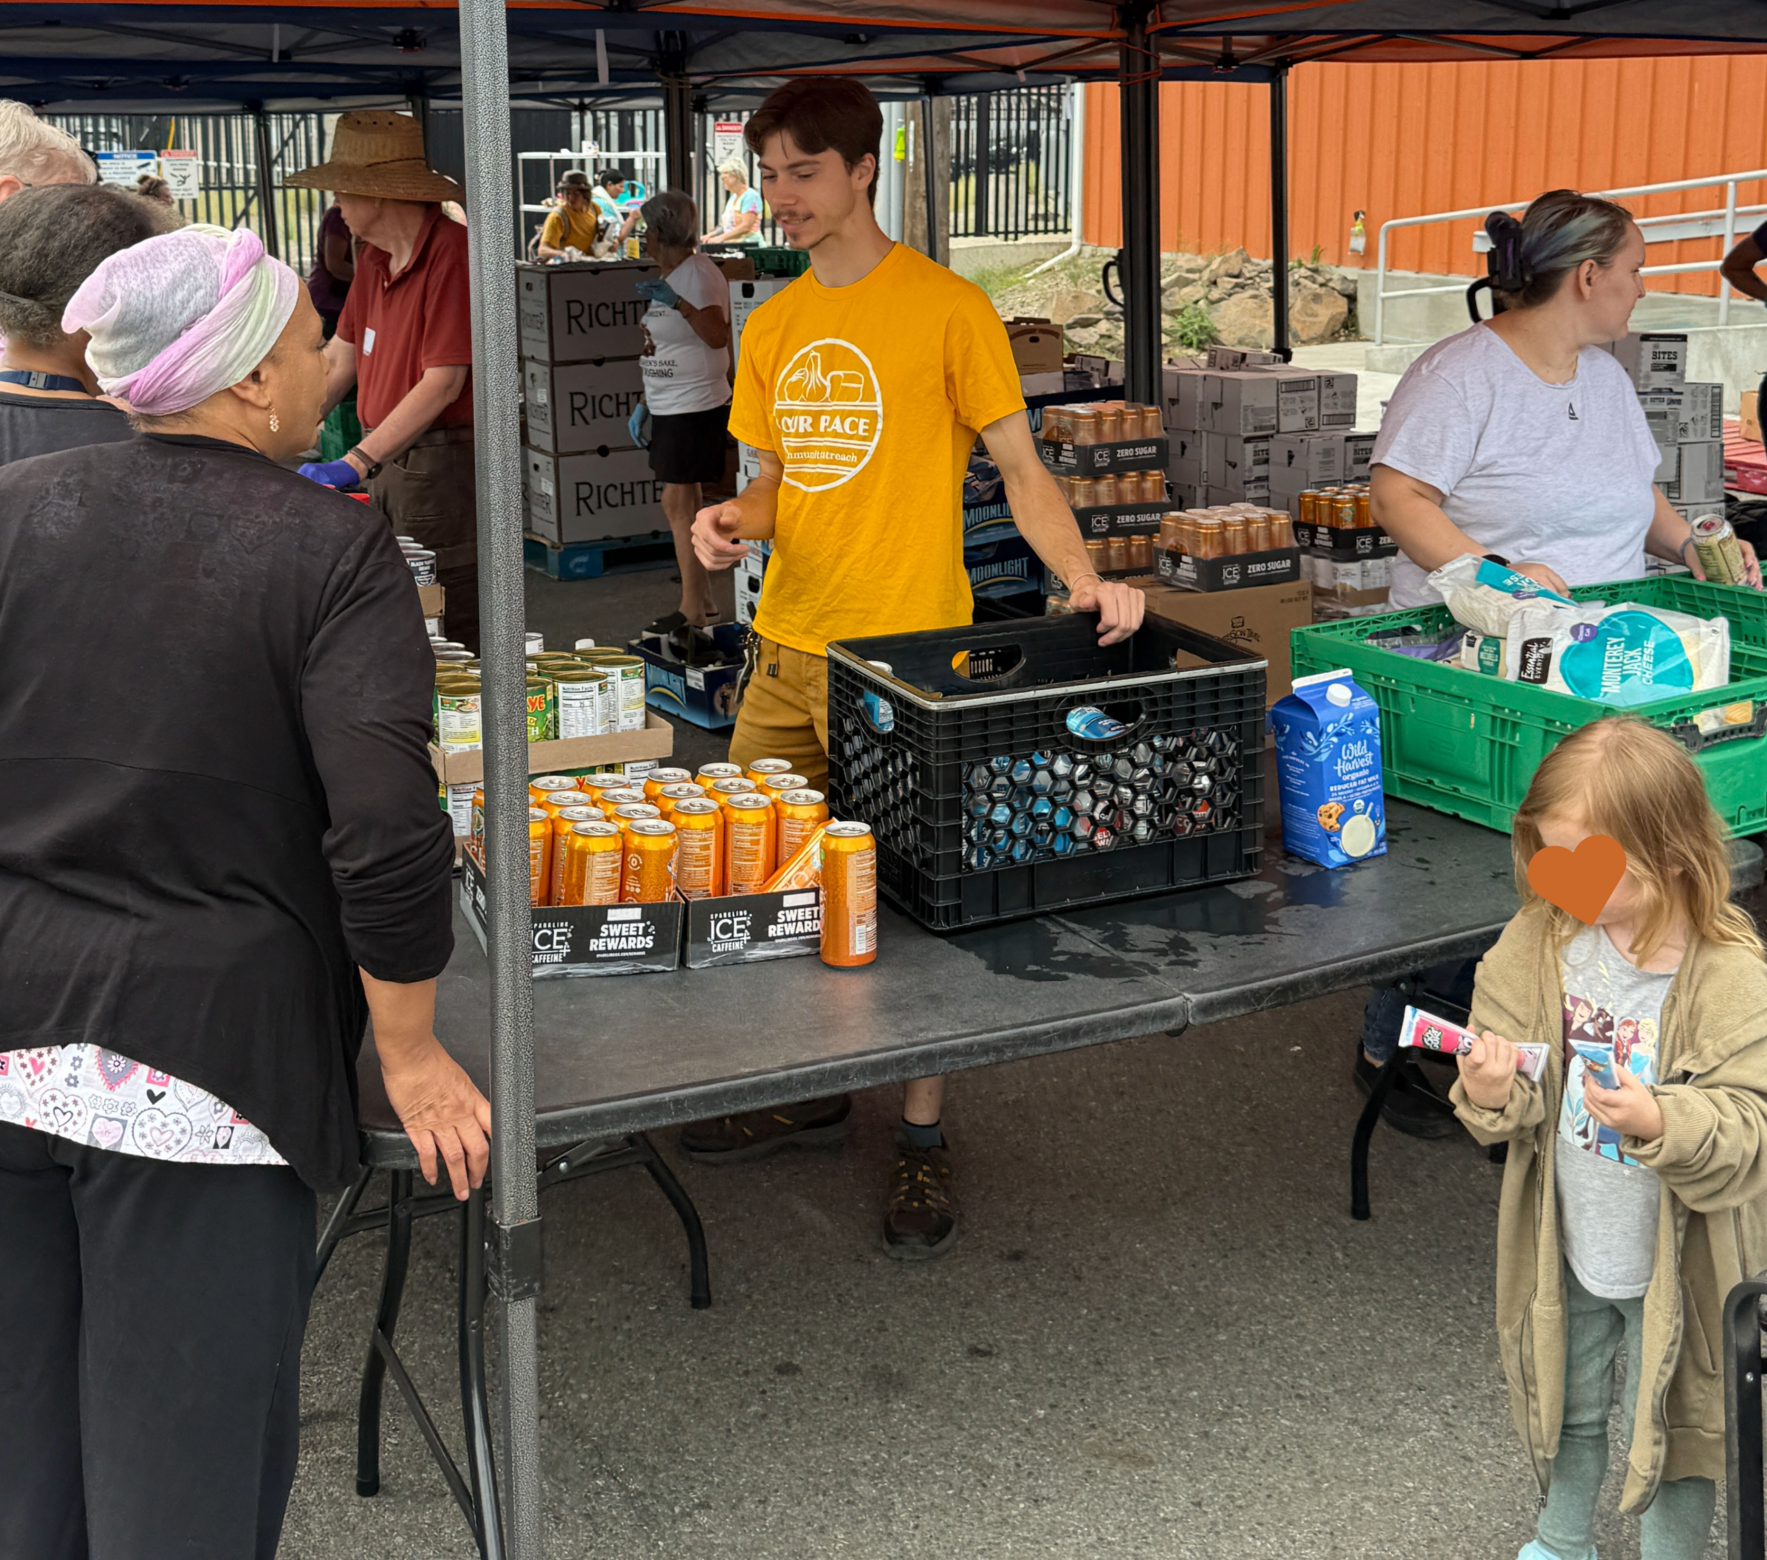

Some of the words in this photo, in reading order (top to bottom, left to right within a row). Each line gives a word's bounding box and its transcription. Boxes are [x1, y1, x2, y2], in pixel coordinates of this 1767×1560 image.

[1652, 351, 1678, 360] BITES
[1094, 451, 1110, 462] ICE
[1116, 447, 1135, 458] ZERO
[1134, 445, 1157, 456] SUGAR
[1091, 516, 1109, 528] ICE
[1116, 514, 1136, 524] ZERO
[1136, 512, 1161, 523] SUGAR
[967, 557, 1029, 586] MOONLIGHT
[1222, 566, 1241, 580] ICE
[1247, 563, 1266, 574] ZERO
[1267, 559, 1292, 571] SUGAR
[1521, 642, 1539, 680] Essential
[1601, 637, 1626, 693] MONTEREY
[1622, 647, 1642, 676] JACK
[1641, 640, 1655, 686] CHEESE
[1342, 739, 1368, 760] Wild
[1333, 752, 1374, 777] Harvest
[1330, 782, 1358, 792] REDUCED
[1358, 778, 1367, 786] FAT
[1367, 774, 1379, 783] MILK
[1342, 768, 1369, 781] organic
[777, 906, 819, 923] SWEET
[600, 922, 646, 937] SWEET
[710, 917, 746, 941] ICE
[768, 919, 820, 938] REWARD
[589, 935, 654, 952] REWARDS
[712, 941, 744, 953] CAFFEINE
